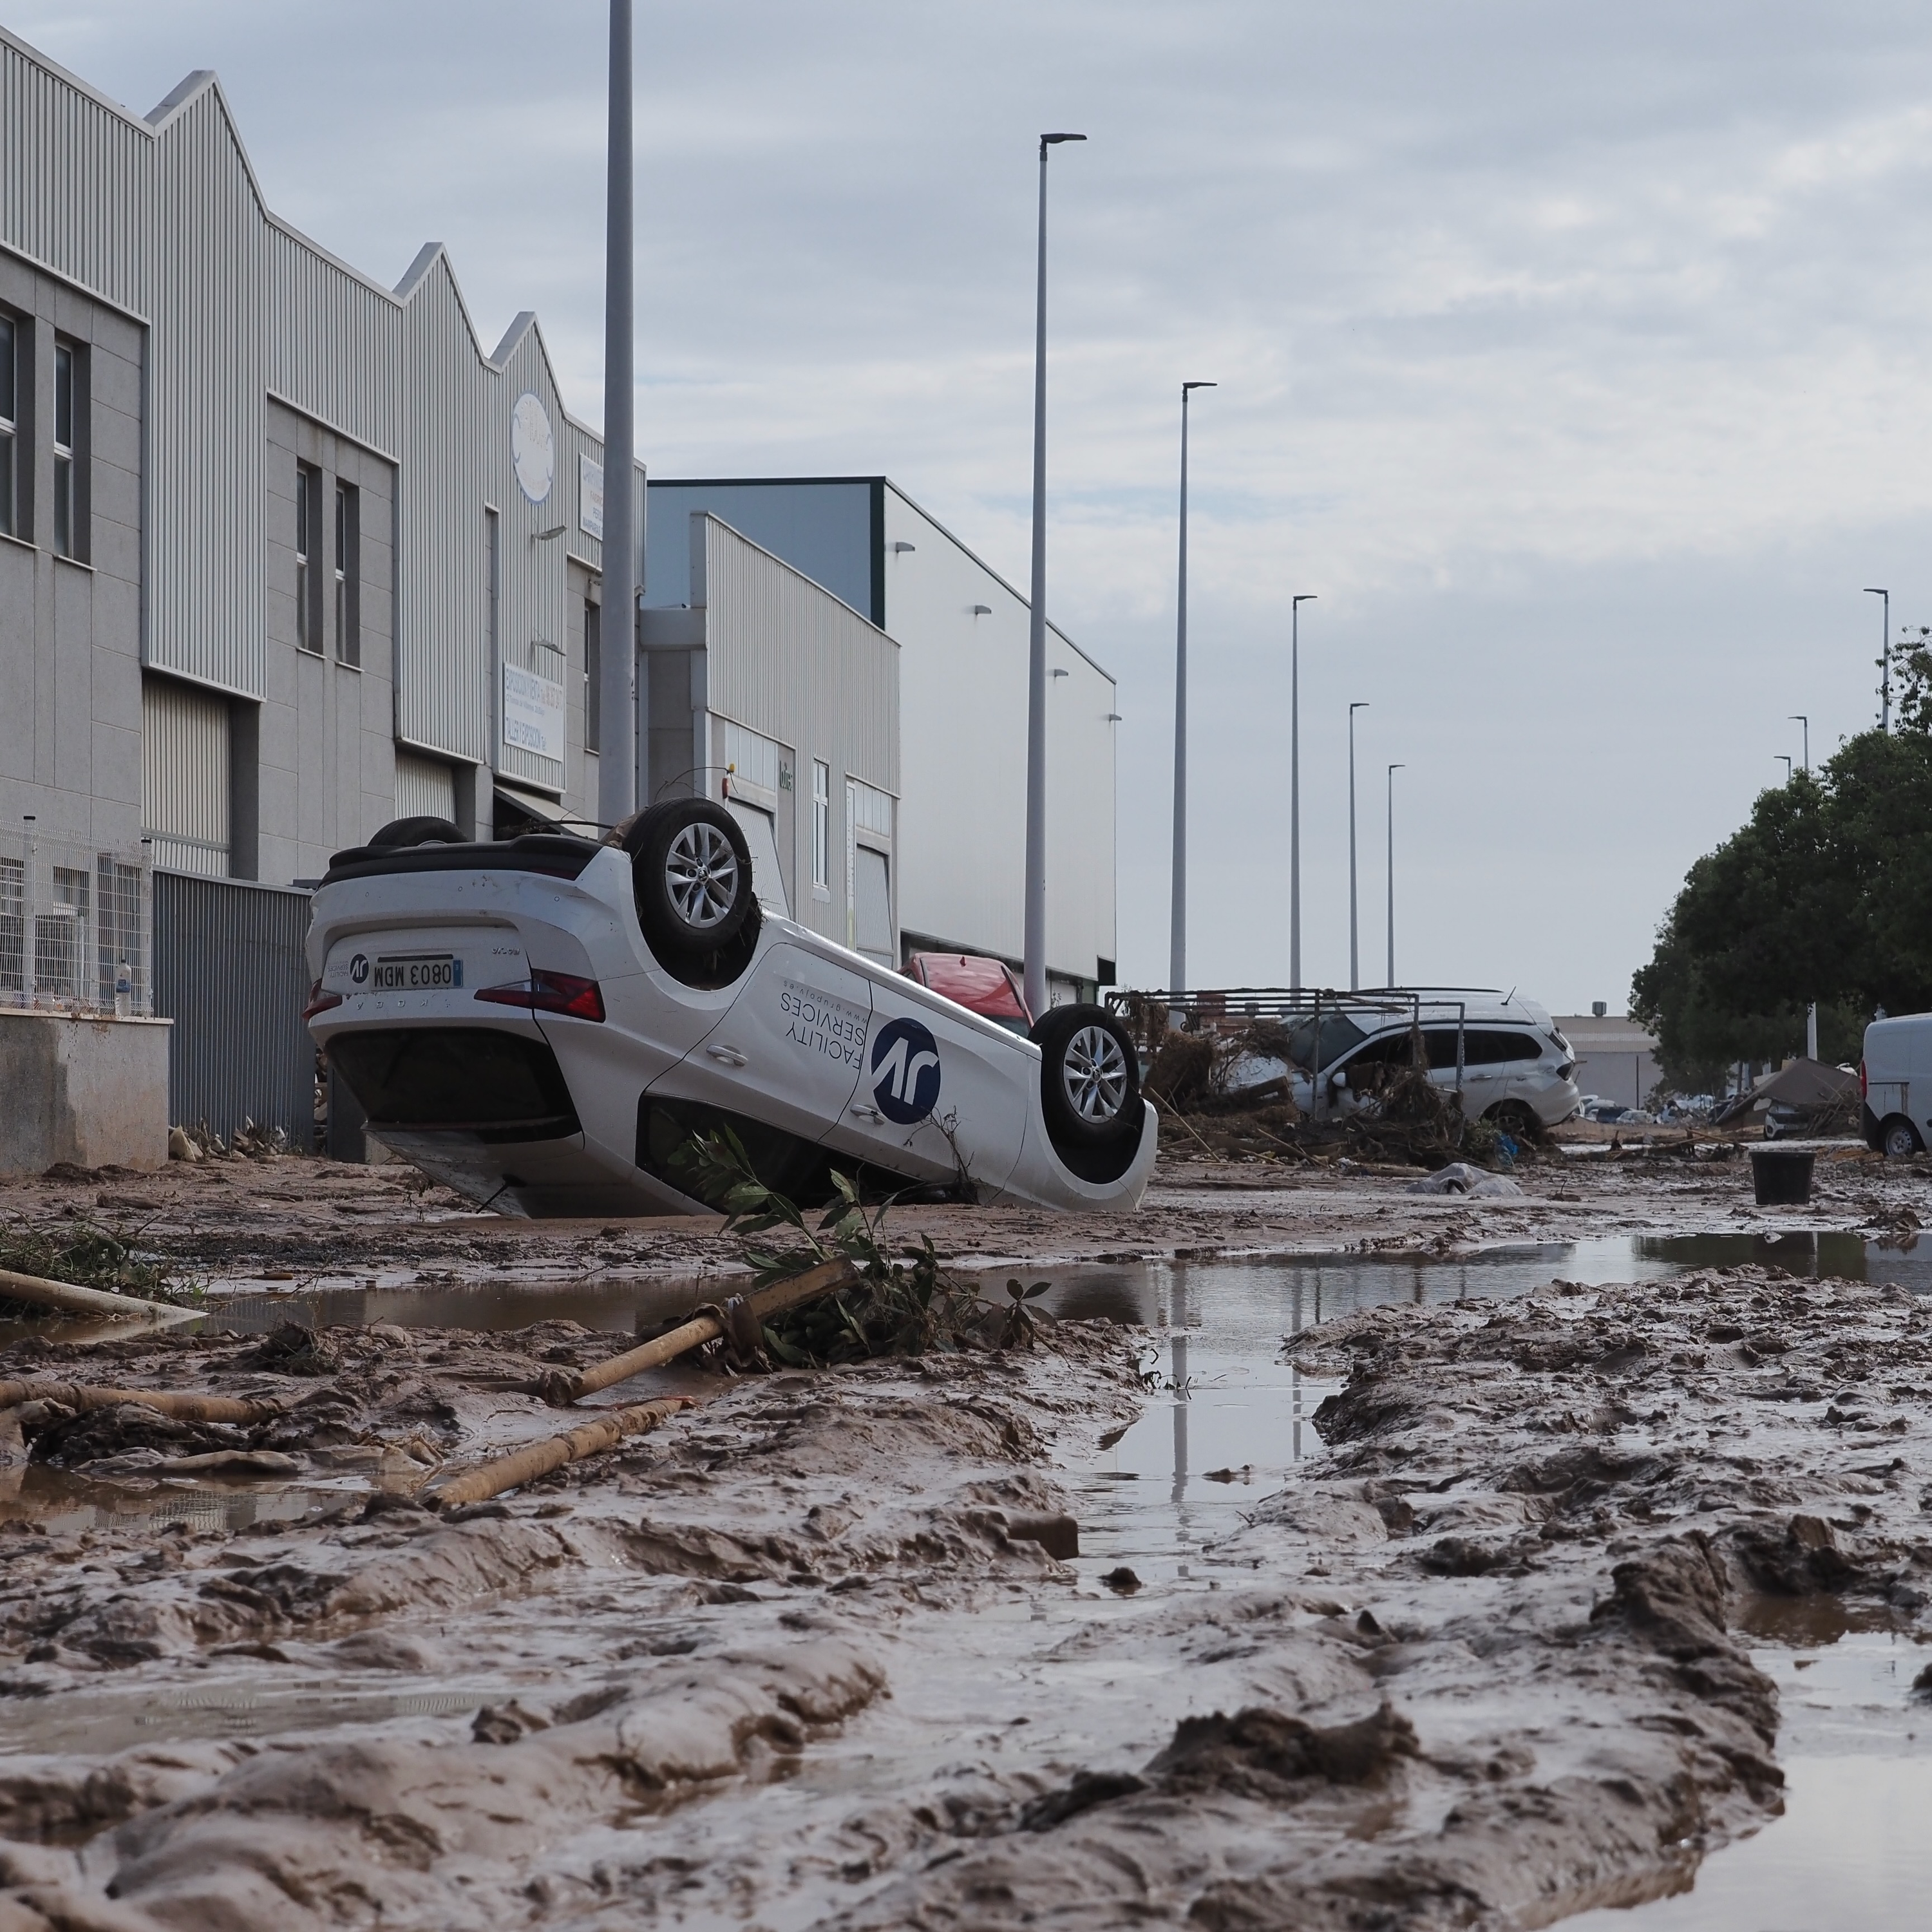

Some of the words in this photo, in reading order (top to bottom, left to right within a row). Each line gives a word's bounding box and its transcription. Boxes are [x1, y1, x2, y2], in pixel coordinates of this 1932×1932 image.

[350, 960, 367, 978] JV
[374, 965, 404, 987] MDM
[410, 963, 451, 986] 0803
[780, 992, 865, 1046] SERVICES
[783, 980, 867, 1025] www.grupojv.es
[786, 1021, 863, 1070] FACILITY
[871, 1037, 939, 1105] JV
